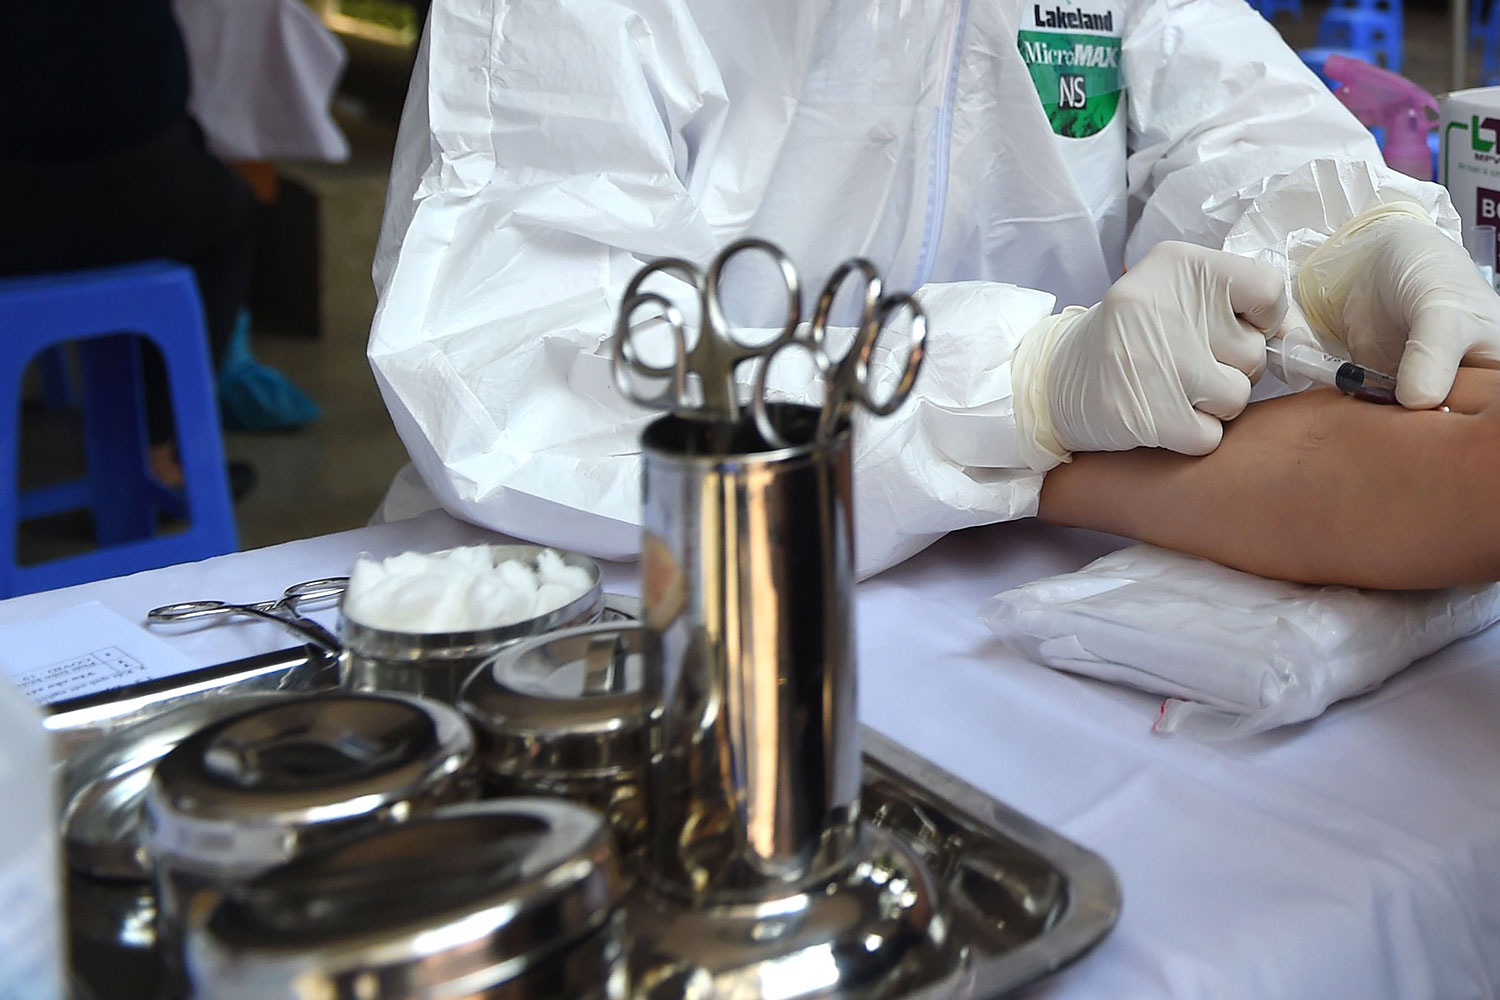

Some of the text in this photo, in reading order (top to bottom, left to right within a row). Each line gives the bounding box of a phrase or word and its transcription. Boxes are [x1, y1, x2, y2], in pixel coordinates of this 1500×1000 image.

[1033, 4, 1114, 31] Lakeland
[1024, 41, 1119, 68] MicroMAX
[1059, 75, 1086, 108] NS
